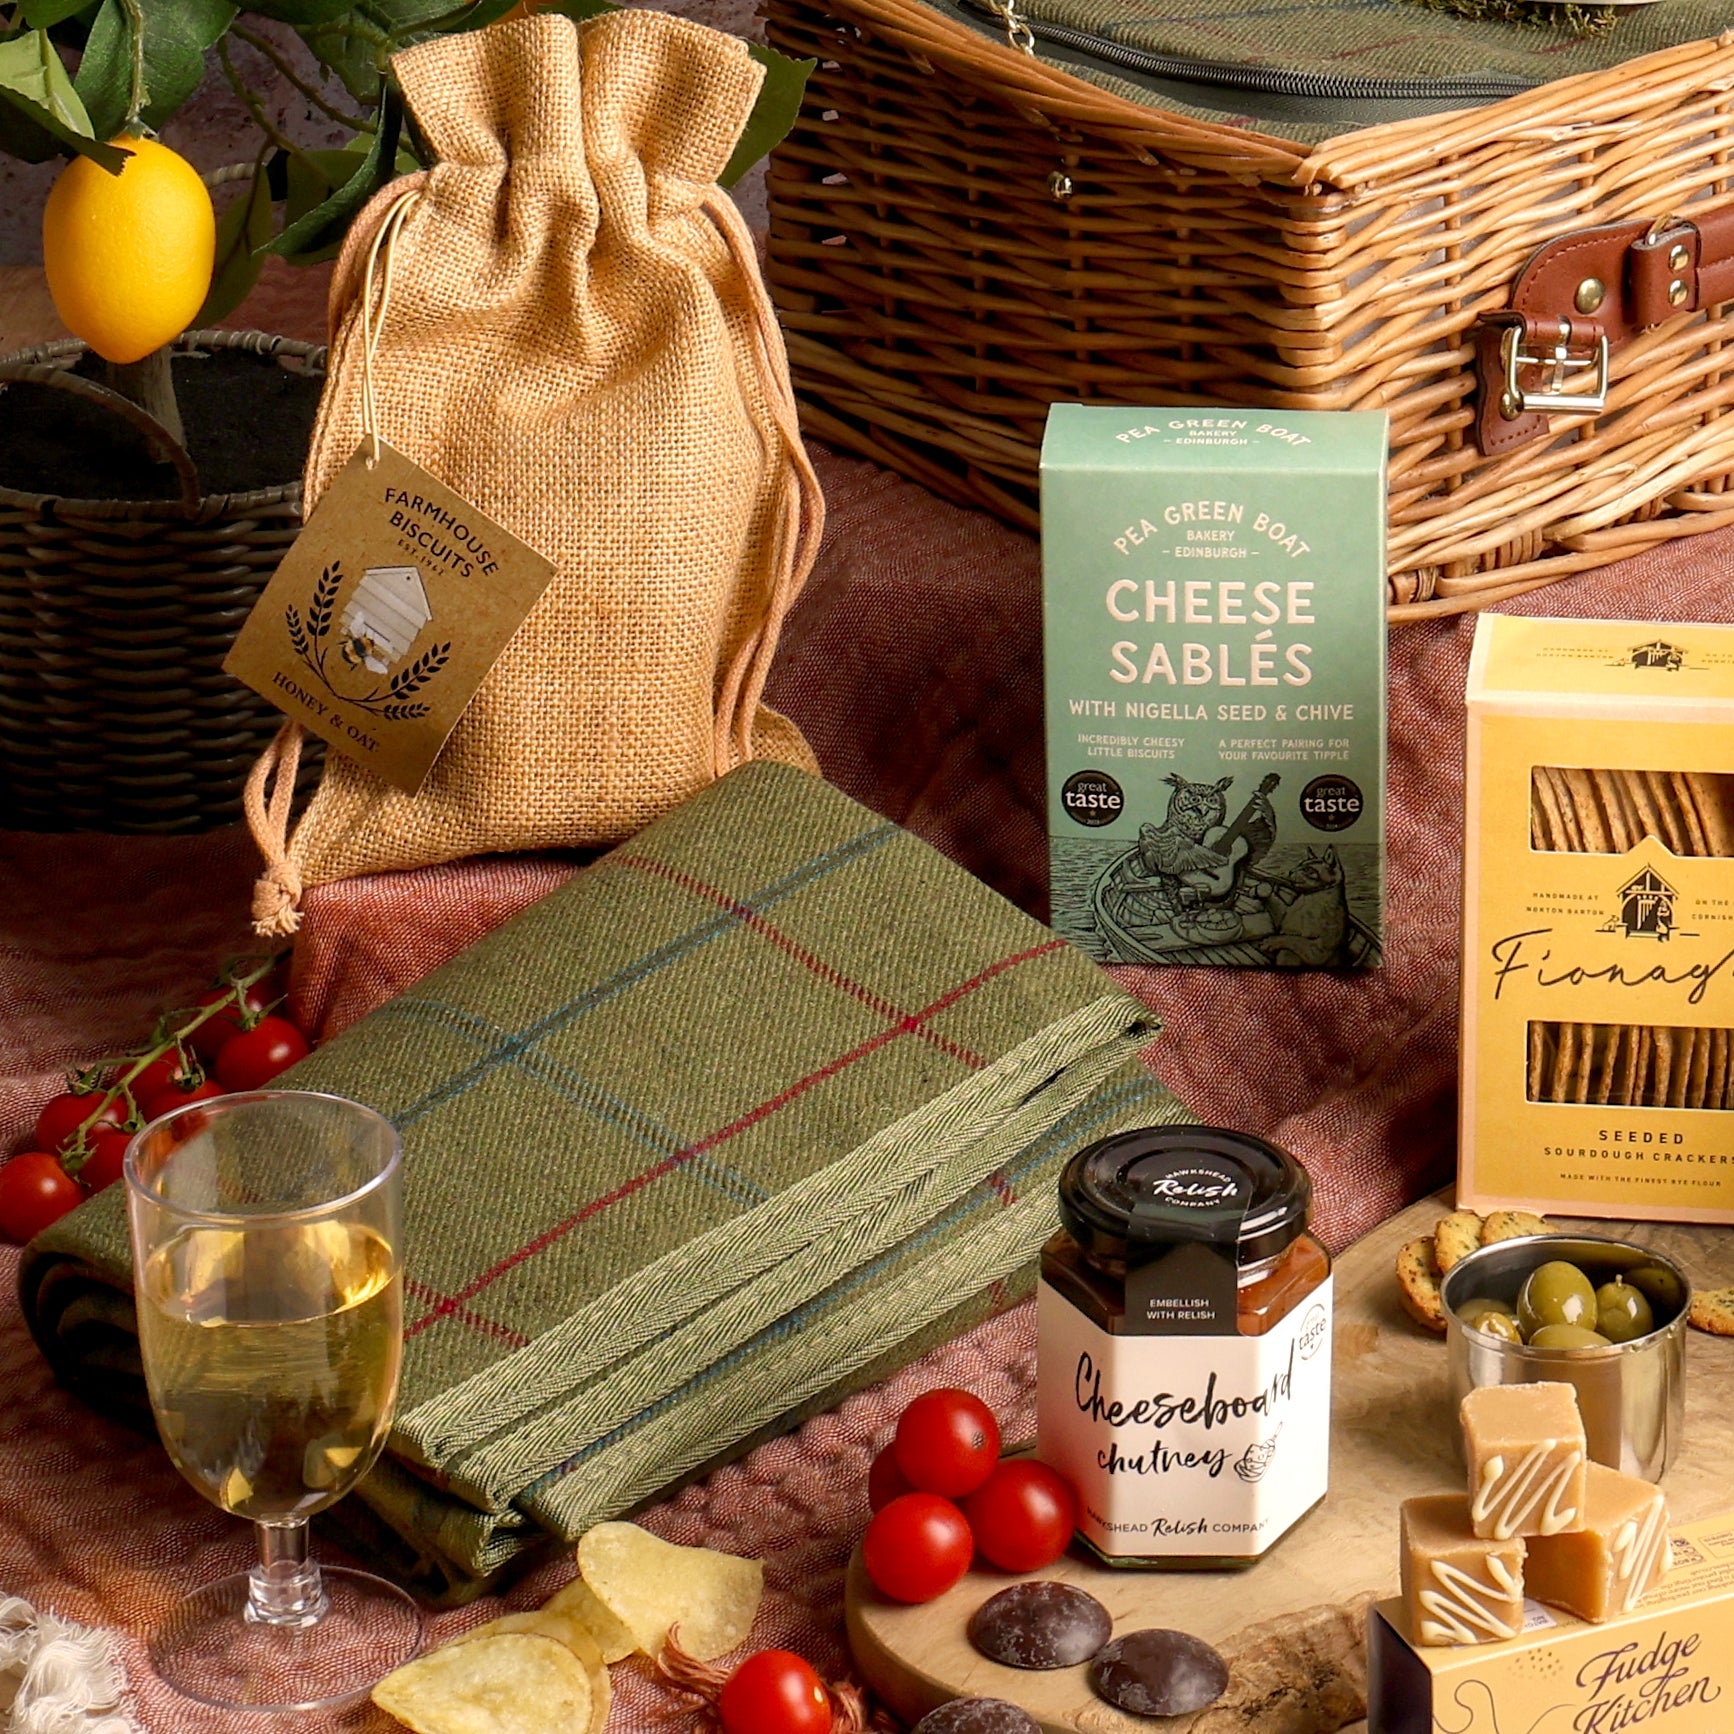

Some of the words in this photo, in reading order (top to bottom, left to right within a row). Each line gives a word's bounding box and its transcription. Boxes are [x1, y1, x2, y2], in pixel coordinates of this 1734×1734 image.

[1115, 425, 1160, 444] PEA
[1168, 418, 1248, 430] GREEN
[1255, 424, 1311, 447] BOAT
[385, 487, 499, 577] FARMHOUSE
[1113, 519, 1157, 555] PEA
[1164, 500, 1244, 525] GREEN
[1252, 511, 1311, 558] BOAT
[1187, 530, 1235, 542] BAKERY
[388, 511, 475, 578] BISCUITS
[1175, 546, 1247, 559] EDINBURGH
[1106, 579, 1315, 624] CHEESE
[1109, 629, 1312, 687] SABLÉS
[272, 671, 328, 717] HONEY
[330, 714, 343, 730] &
[347, 724, 380, 752] OAT
[1069, 699, 1115, 717] WITH
[1126, 702, 1208, 721] NIGELLA
[1217, 704, 1267, 721] SEED
[1275, 704, 1287, 721] &
[1296, 704, 1354, 721] CHIVE
[1078, 733, 1139, 746] INCREDIBLY
[1143, 737, 1185, 747] CHEESY
[1218, 739, 1227, 748] A
[1230, 739, 1277, 748] PERFECT
[1282, 738, 1324, 748] PAIRING
[1328, 738, 1349, 748] FOR
[1087, 746, 1123, 757] LITTLE
[1128, 749, 1175, 759] BISCUITS
[1218, 751, 1247, 760] YOUR
[1252, 750, 1309, 760] FAVOURITE
[1314, 750, 1349, 760] TIPPLE
[1077, 782, 1107, 793] great
[1316, 787, 1346, 798] great
[1065, 791, 1121, 809] taste
[1304, 797, 1360, 813] taste
[1491, 928, 1734, 1004] Fionag
[1599, 1130, 1684, 1145] SEEDED
[1544, 1147, 1644, 1161] SOURDOUGH
[1153, 1179, 1238, 1198] Relish
[1149, 1299, 1209, 1308] EMBELLISH
[1147, 1311, 1175, 1320] WITH
[1177, 1311, 1216, 1320] RELISH
[1299, 1318, 1326, 1350] taste
[1075, 1338, 1295, 1430] Cheeseboard
[1097, 1440, 1233, 1478] chutney
[1151, 1517, 1208, 1537] Relish
[1576, 1631, 1702, 1700] Fudge
[1573, 1676, 1721, 1734] Kitchen
